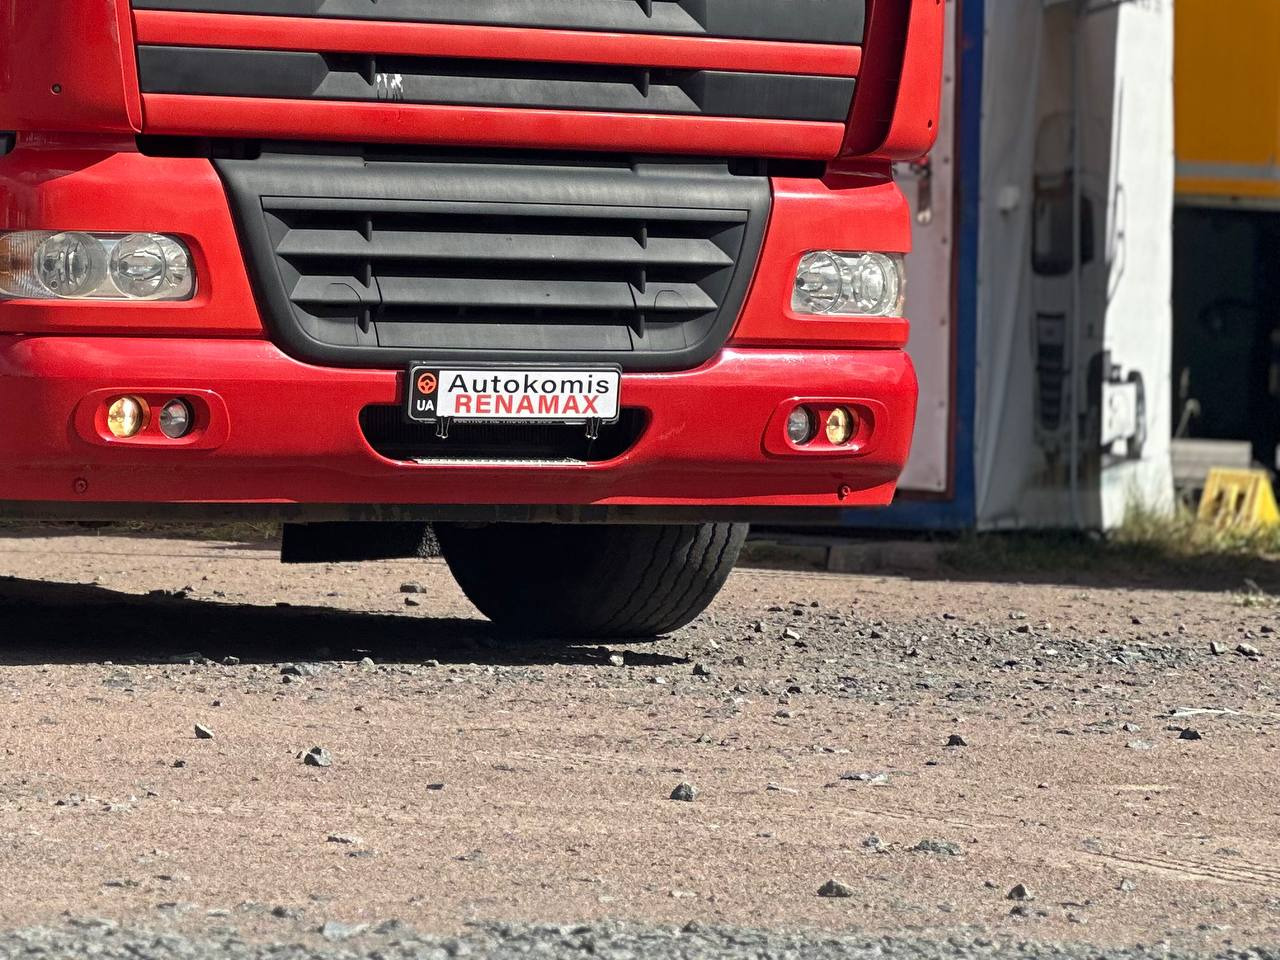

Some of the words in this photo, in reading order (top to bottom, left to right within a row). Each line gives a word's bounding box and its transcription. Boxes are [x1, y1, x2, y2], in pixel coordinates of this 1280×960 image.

[448, 374, 610, 394] Autokomis
[416, 399, 435, 411] UA
[455, 394, 599, 414] RENAMAX
